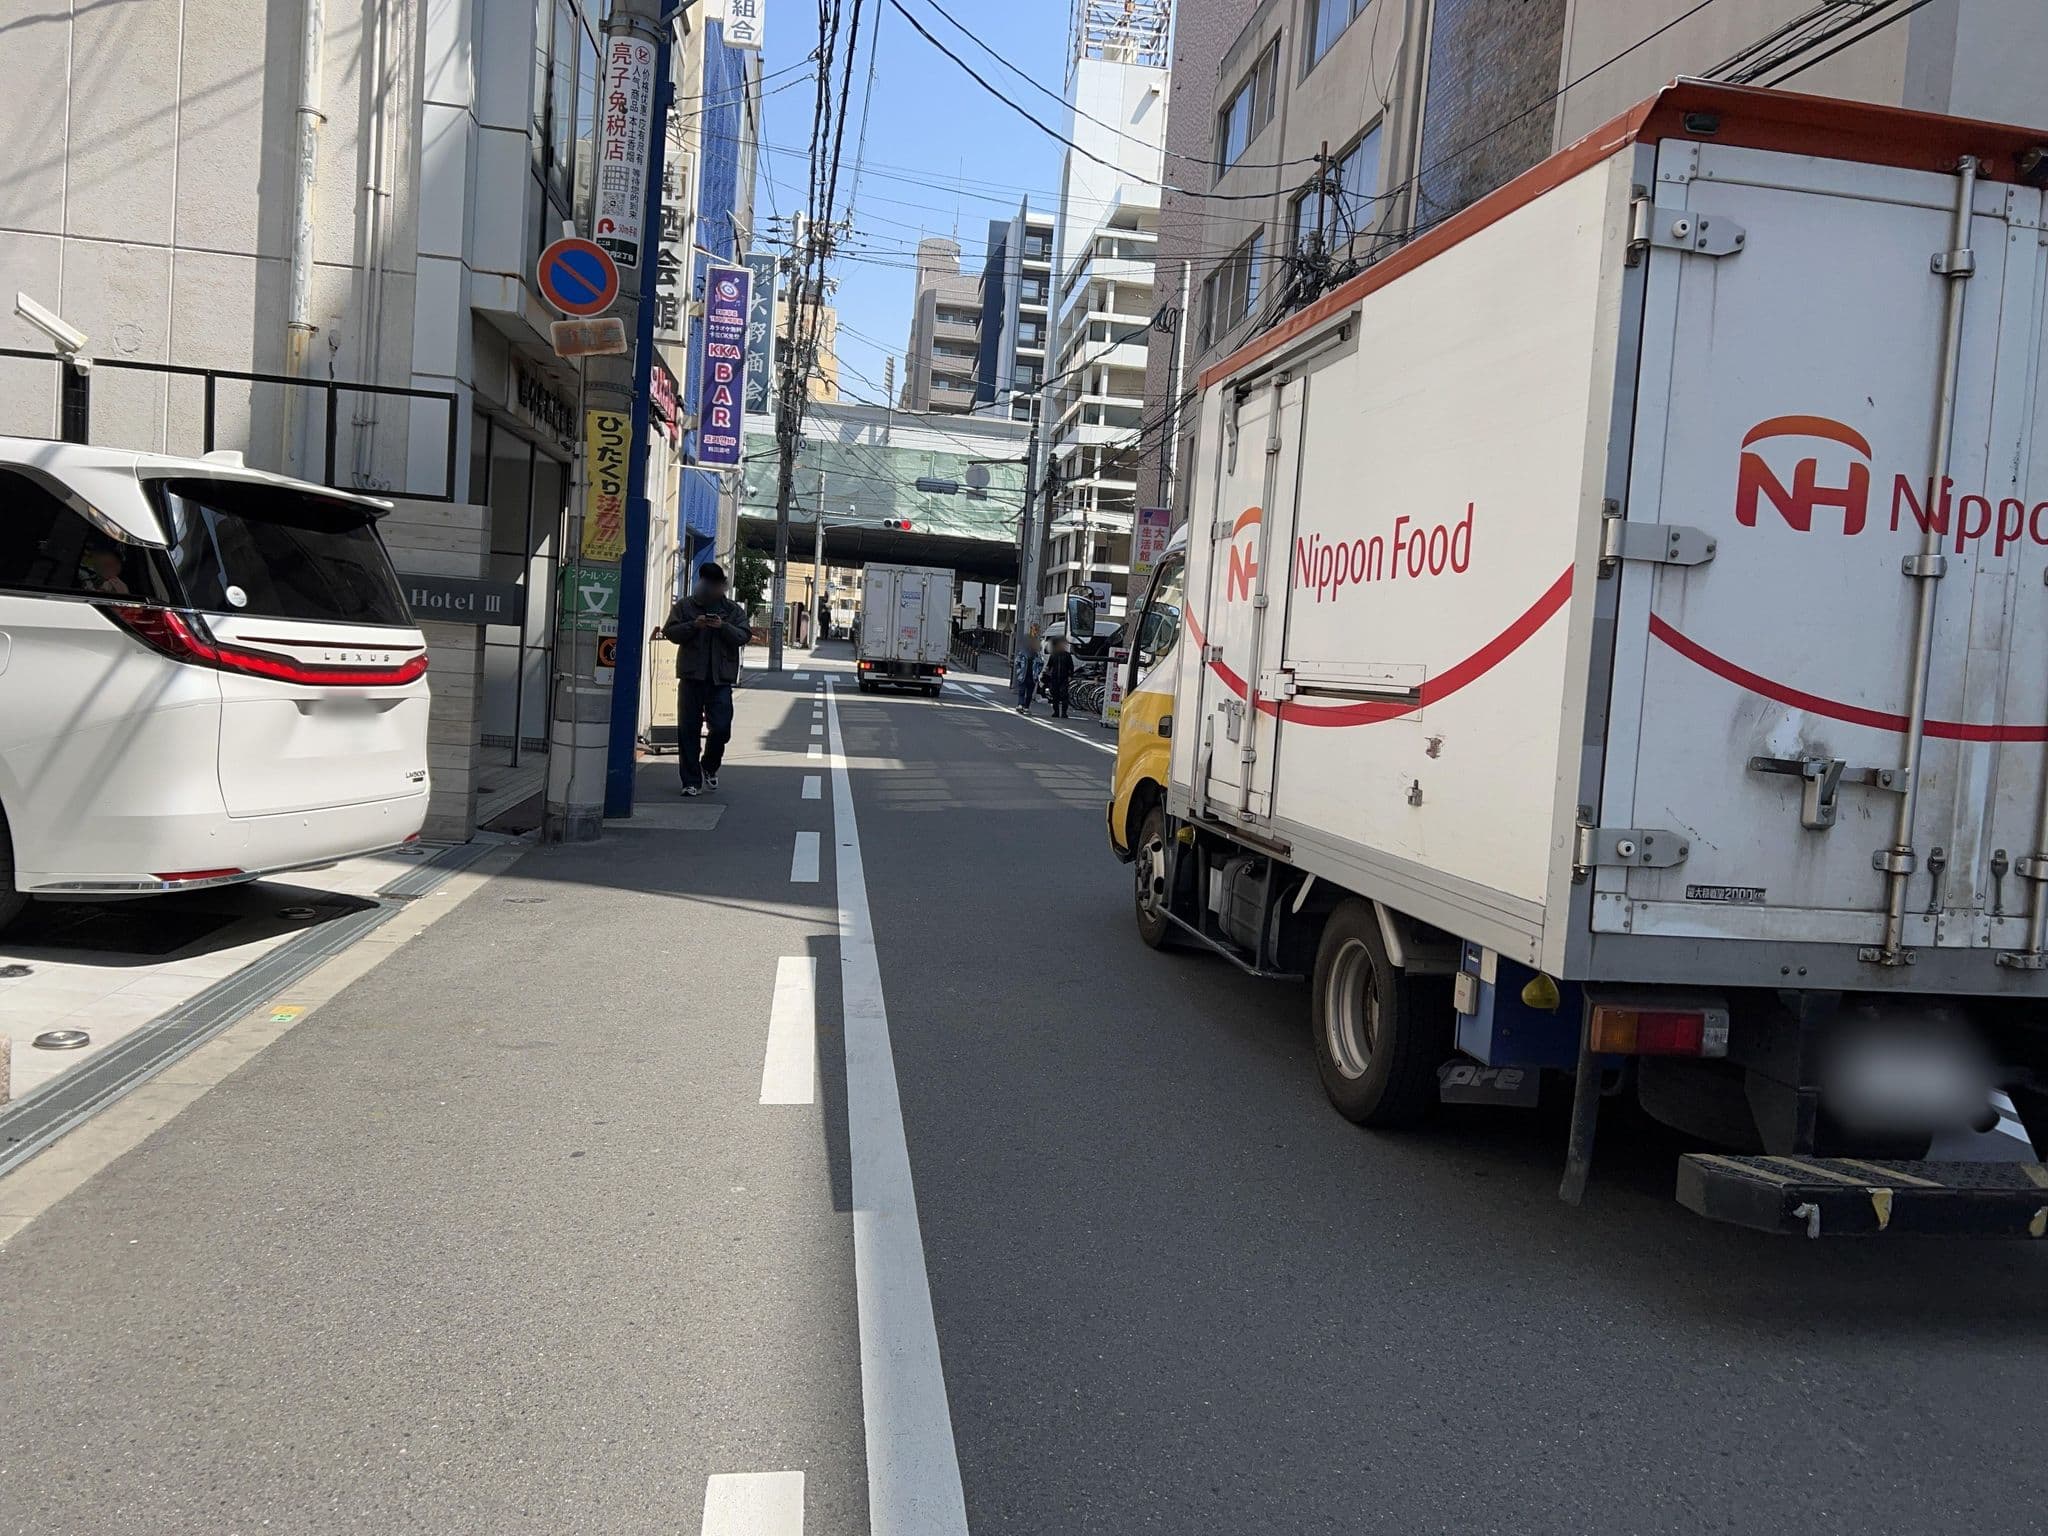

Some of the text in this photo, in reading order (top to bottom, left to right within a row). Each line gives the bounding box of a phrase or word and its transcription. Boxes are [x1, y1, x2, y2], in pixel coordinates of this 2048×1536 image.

[731, 0, 756, 41] 組合
[709, 343, 740, 359] KKA
[712, 362, 733, 428] BAR
[1736, 451, 1872, 536] NH
[1295, 533, 1385, 603] Nippon
[1391, 502, 1475, 579] Food
[411, 588, 475, 610] Hotel
[324, 652, 390, 662] LEXUS
